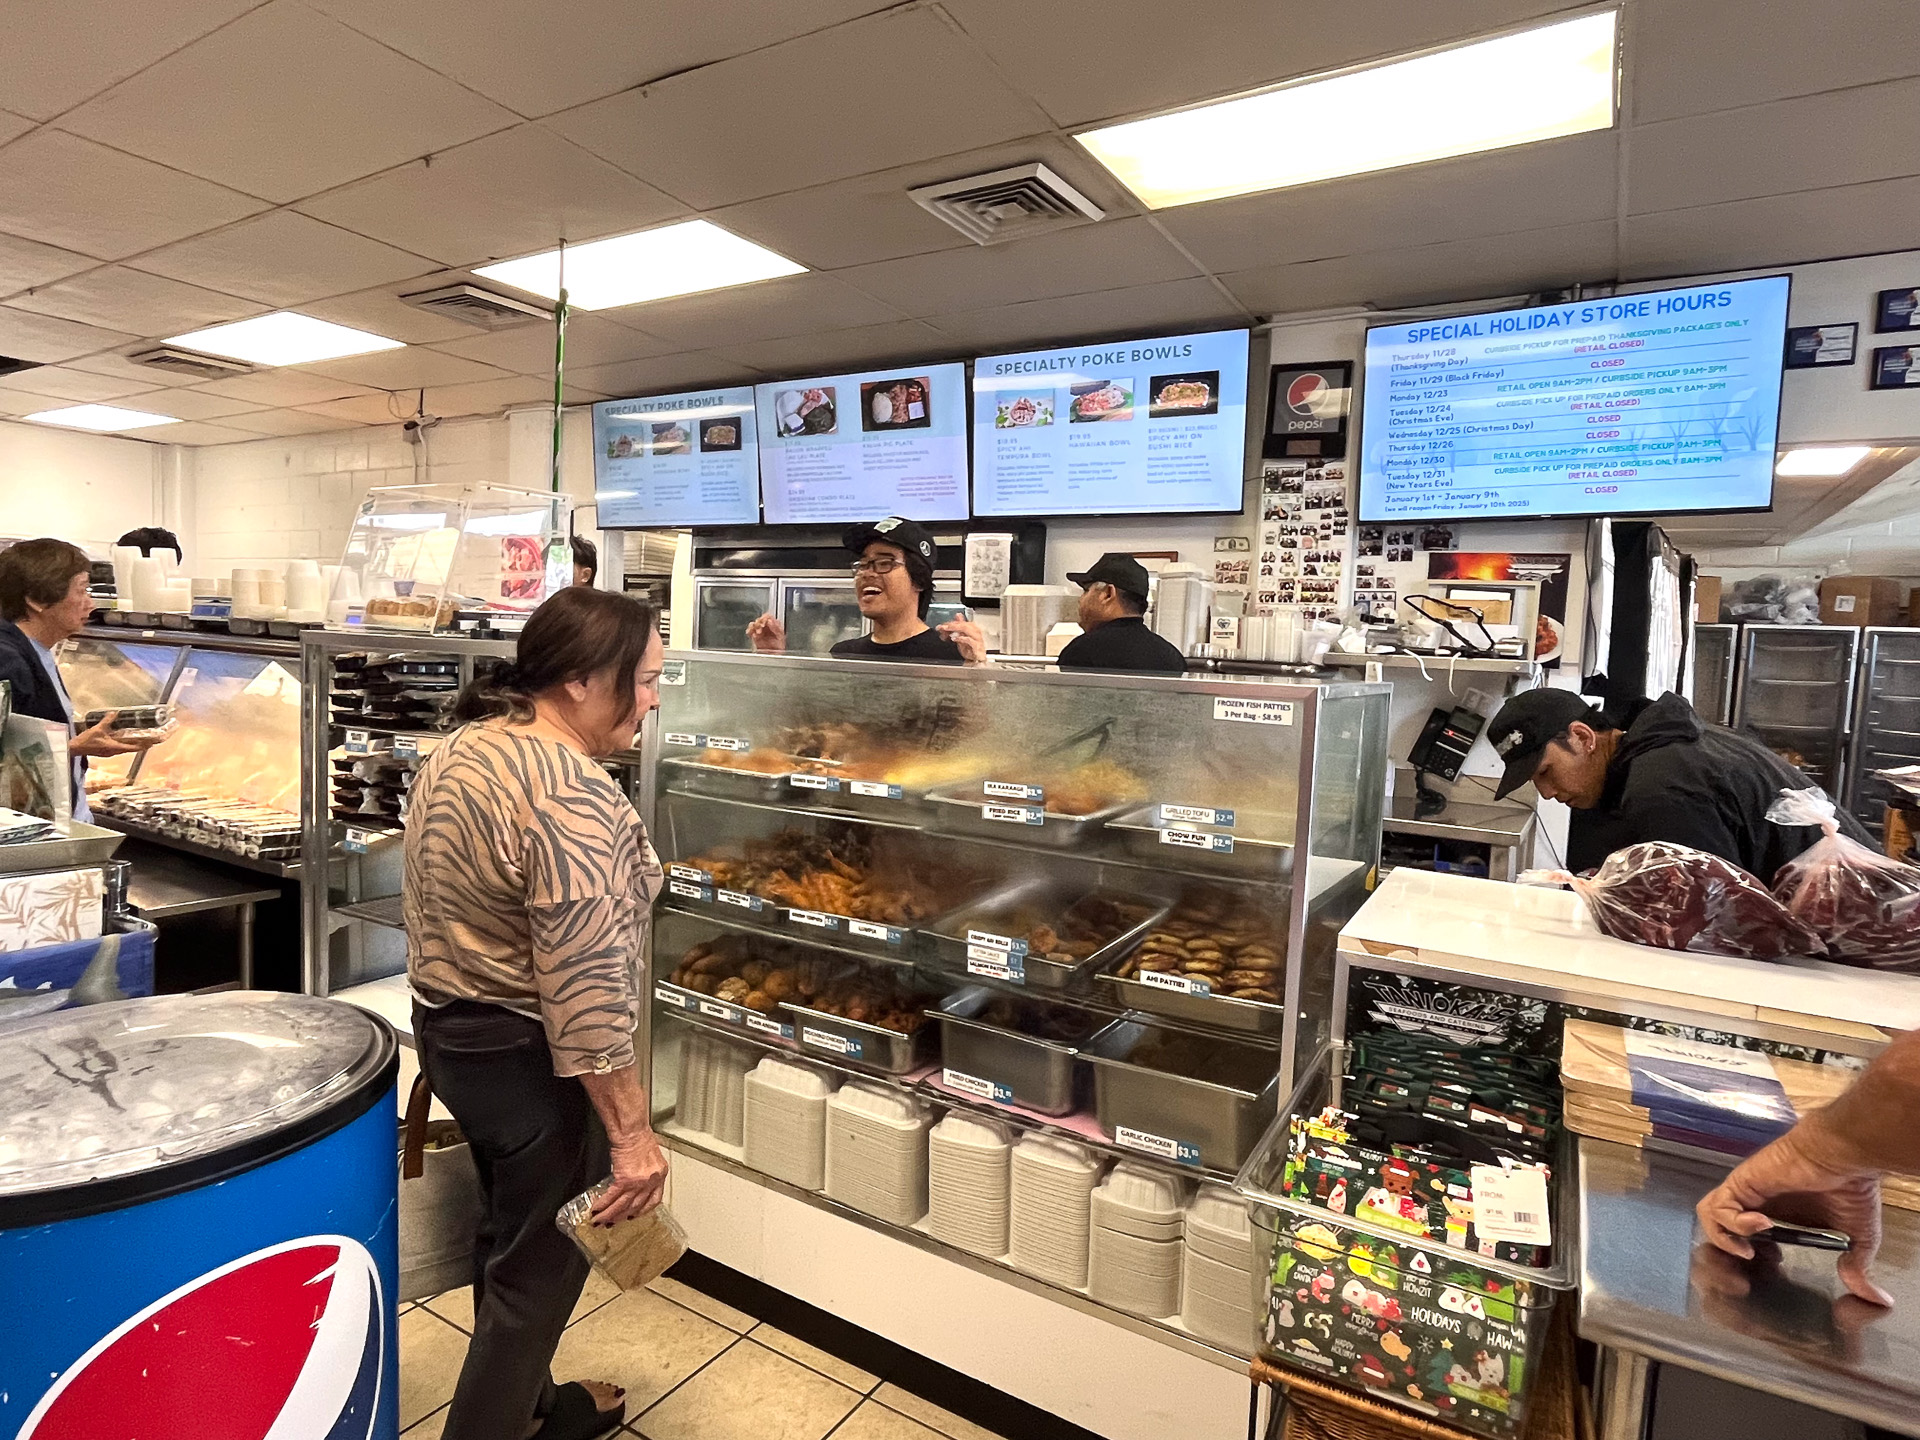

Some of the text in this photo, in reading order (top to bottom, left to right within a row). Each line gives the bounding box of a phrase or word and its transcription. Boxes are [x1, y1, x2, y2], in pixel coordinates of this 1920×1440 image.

[1408, 291, 1732, 343] SPECIAL HOLIDAY STORE HOURS
[1484, 318, 1749, 354] CURBSIDE PICKUP FOR PREPAID THANKSGIVING PACKAGES ONLY
[1573, 339, 1645, 354] (RETAIL CLOSED)
[995, 344, 1192, 375] SPECIALTY POKE BOWLS
[1392, 347, 1456, 363] Thursday 11/28
[1391, 356, 1469, 373] (Thanksgiving Day)
[1590, 358, 1625, 369] CLOSED
[1390, 368, 1505, 388] Friday 11/29 (Black Friday)
[1497, 382, 1526, 392] RETAIL
[1529, 380, 1550, 390] OPEN
[1601, 371, 1644, 384] CURBSIDE
[1647, 368, 1680, 378] PICKUP
[1683, 364, 1727, 376] 9AM-3PM
[1389, 389, 1448, 402] Monday 12/23
[1496, 399, 1533, 408] CURBSIDE
[1535, 396, 1553, 405] PICK
[1585, 390, 1621, 400] PREPAID
[1623, 387, 1656, 397] ORDERS
[1658, 385, 1682, 394] ONLY
[605, 396, 724, 416] SPECIALTY POKE BOWLS
[1390, 405, 1451, 417] Tuesday 12/24
[1570, 398, 1641, 411] (RETAIL CLOSED)
[1288, 420, 1323, 431] pepsi
[1389, 413, 1454, 426] (Christmas Eve)
[1587, 414, 1621, 424] CLOSED
[1388, 420, 1534, 439] Wednesday 12/25 (Christmas Day)
[1585, 430, 1620, 439] CLOSED
[1388, 441, 1454, 452] Thursday 12/26
[1493, 451, 1522, 460] RETAIL
[1524, 450, 1546, 458] OPEN
[1597, 443, 1640, 454] CURBSIDE
[1642, 441, 1675, 451] PICKUP
[1677, 439, 1721, 449] 9AM-3PM
[1386, 455, 1445, 467] Monday 12/30
[1494, 465, 1531, 475] CURBSIDE
[1533, 464, 1551, 472] PICK
[1565, 463, 1582, 471] FOR
[1583, 460, 1618, 470] PREPAID
[1620, 458, 1654, 468] ORDERS
[1655, 456, 1679, 465] ONLY
[1387, 470, 1446, 482] Tuesday 12/31
[1568, 469, 1637, 480] (RETAIL CLOSED)
[1386, 479, 1453, 490] (New Years Eve)
[1585, 485, 1618, 494] CLOSED
[1385, 490, 1500, 503] January 1st January 9th
[1458, 502, 1488, 510] January
[1507, 500, 1530, 508] 2025)
[1217, 700, 1291, 711] FROZEN FISH PATTIES
[1243, 712, 1256, 721] Bag
[1262, 713, 1282, 722] $8.95
[1165, 807, 1191, 816] GRILLED
[1192, 809, 1210, 818] TOFU
[1167, 831, 1206, 842] CHOW FUN
[1160, 977, 1185, 988] PATTIES
[1388, 1006, 1486, 1030] SEAFOODS AND CATERING
[964, 1077, 988, 1089] CHICKEN
[1120, 1130, 1173, 1149] GARLIC CHICKEN
[1297, 1264, 1319, 1277] HOWZIT
[1293, 1271, 1312, 1284] SANTA
[1402, 1282, 1432, 1298] HOWZIT
[1351, 1312, 1376, 1329] MERRY
[1410, 1306, 1462, 1334] HOLIDAYS
